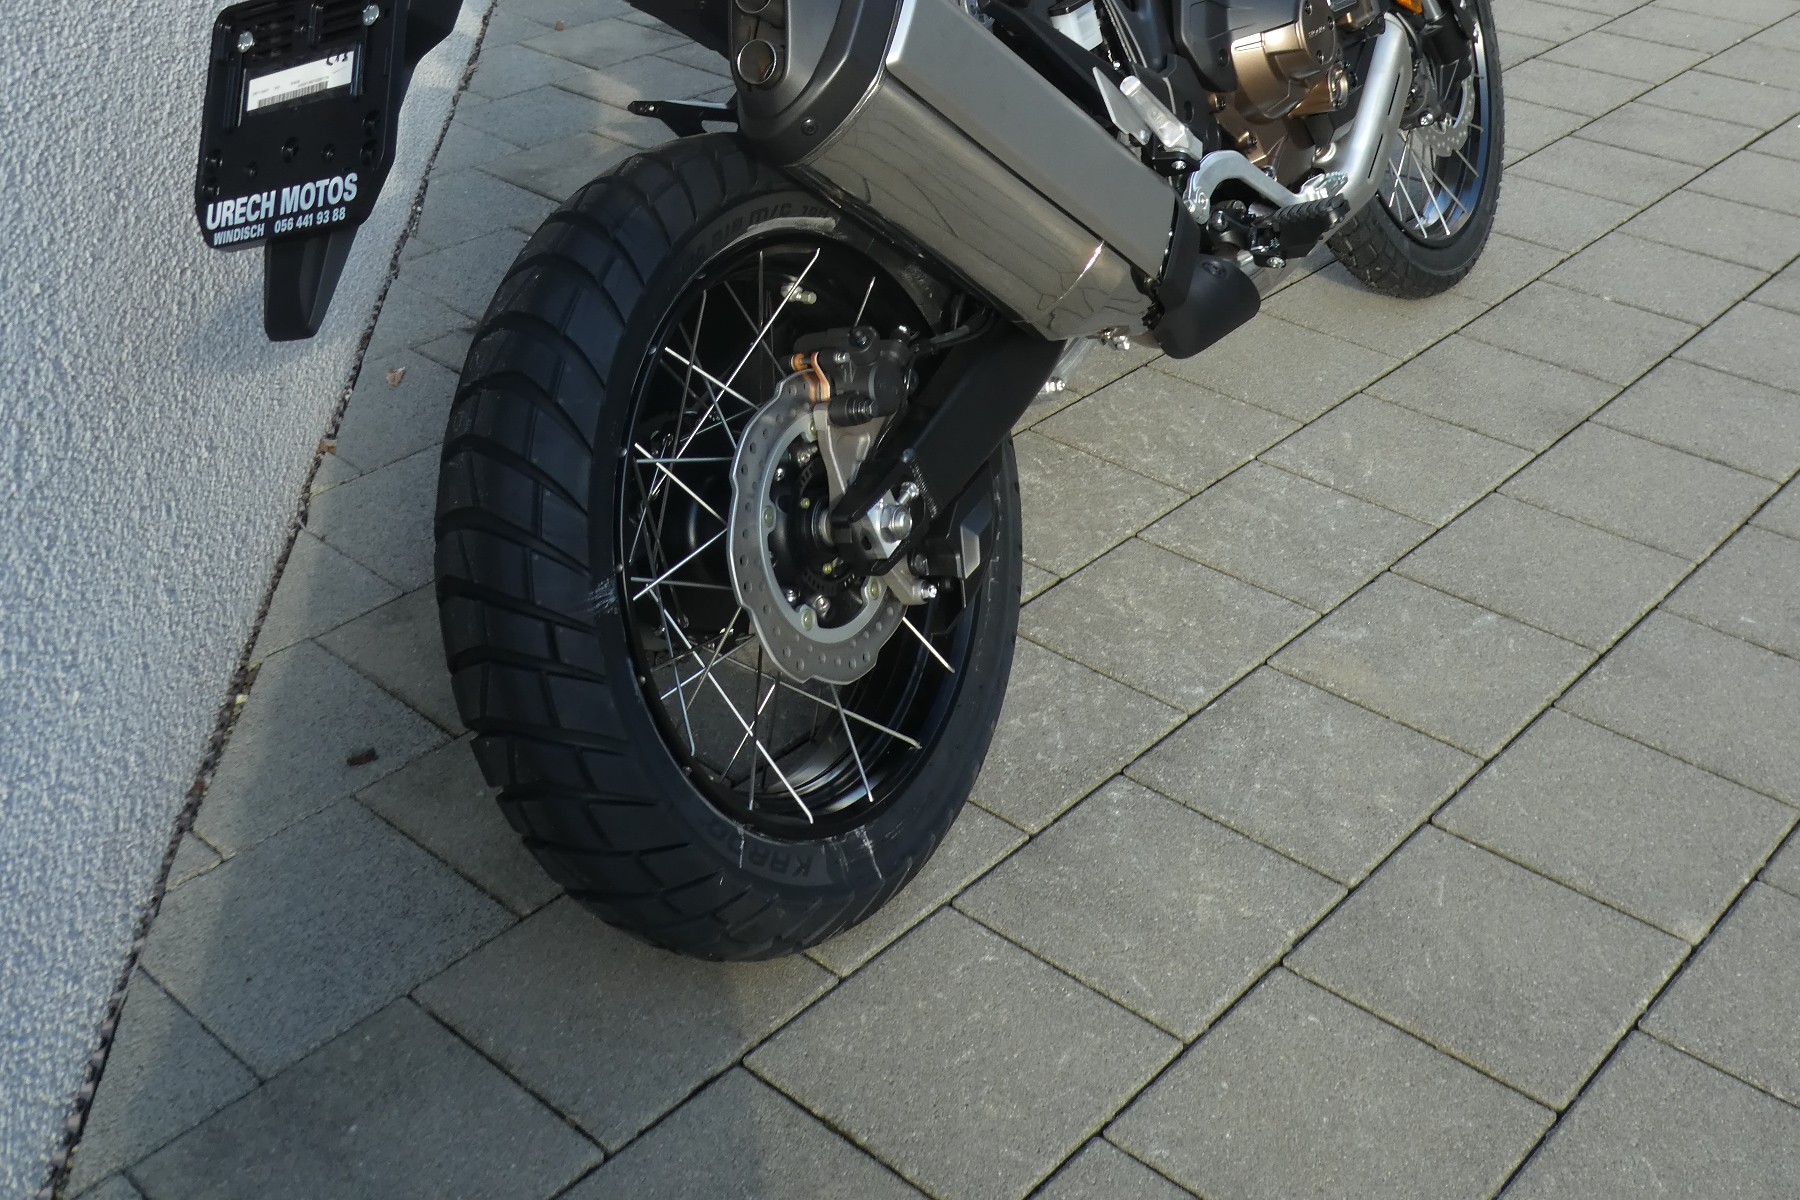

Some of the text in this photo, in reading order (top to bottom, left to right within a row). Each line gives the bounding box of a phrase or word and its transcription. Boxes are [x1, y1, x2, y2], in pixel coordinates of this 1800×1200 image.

[206, 172, 358, 231] URECH MOTOS
[213, 206, 346, 246] WINDISCH 056 441 93 88
